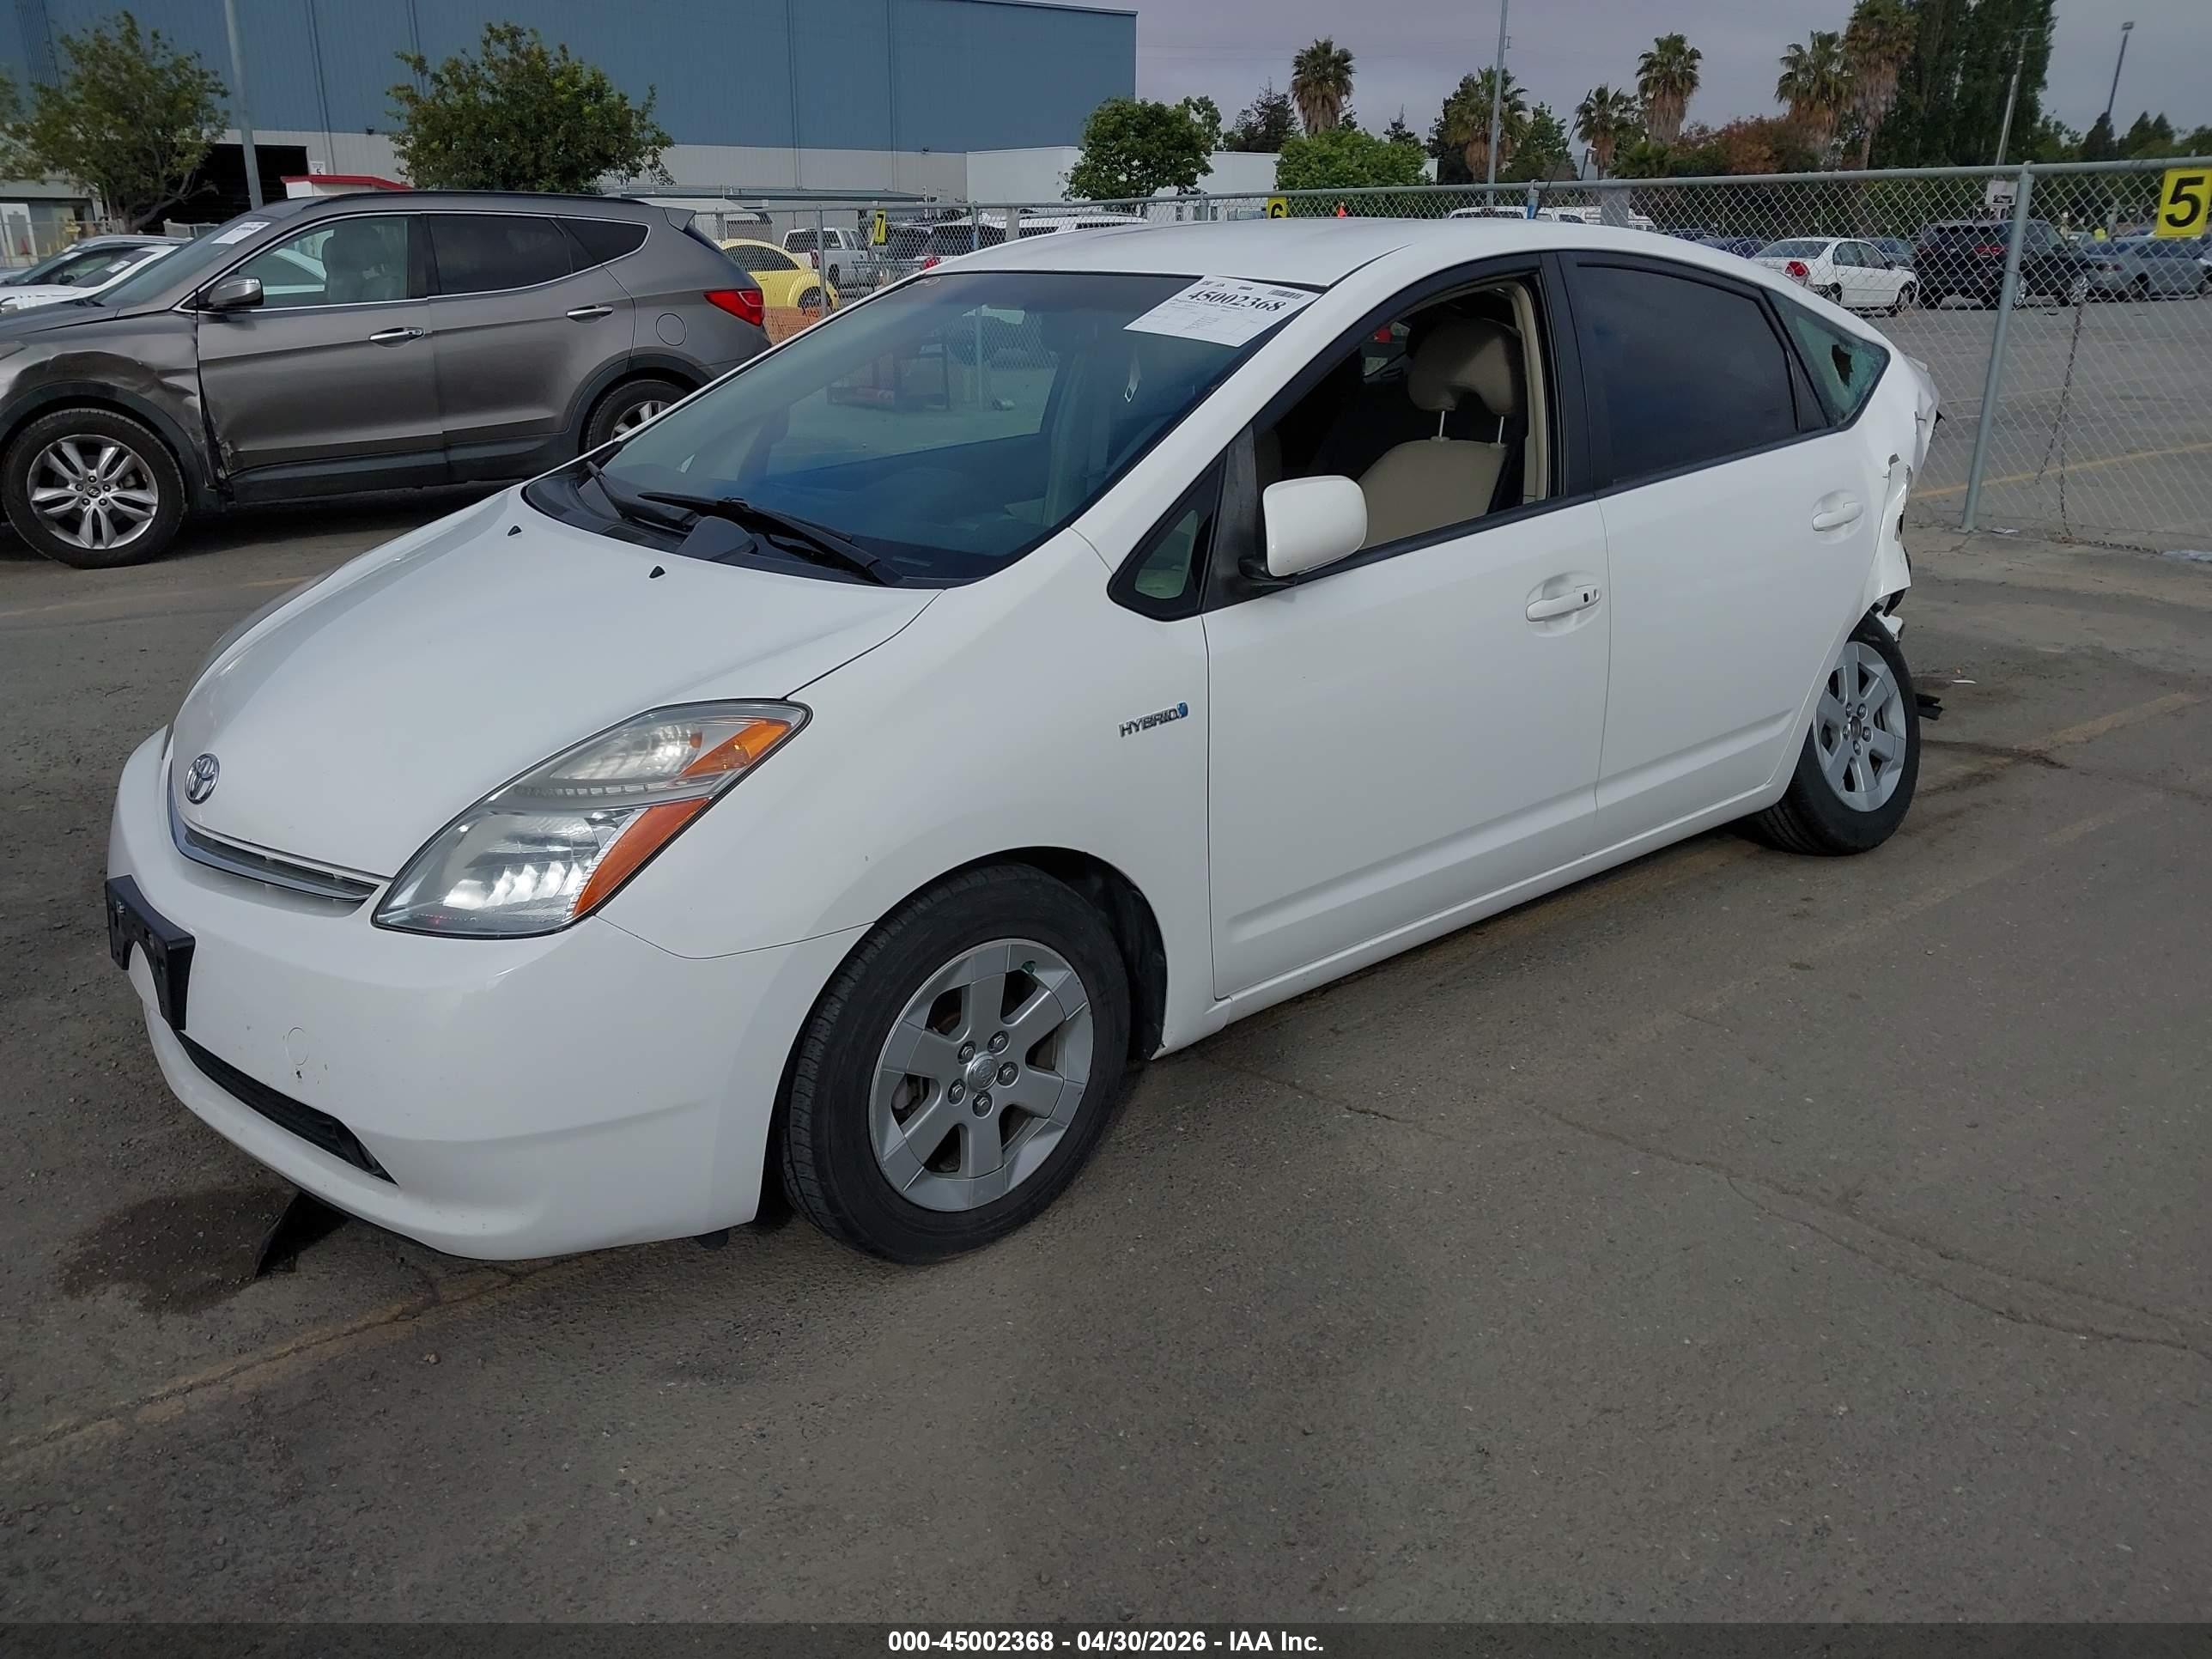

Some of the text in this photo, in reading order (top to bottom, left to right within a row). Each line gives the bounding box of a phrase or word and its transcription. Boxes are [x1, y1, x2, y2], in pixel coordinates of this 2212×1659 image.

[2166, 176, 2205, 228] 5
[877, 214, 884, 237] 7
[1188, 289, 1287, 312] 45002368
[1118, 708, 1177, 738] HYBRID
